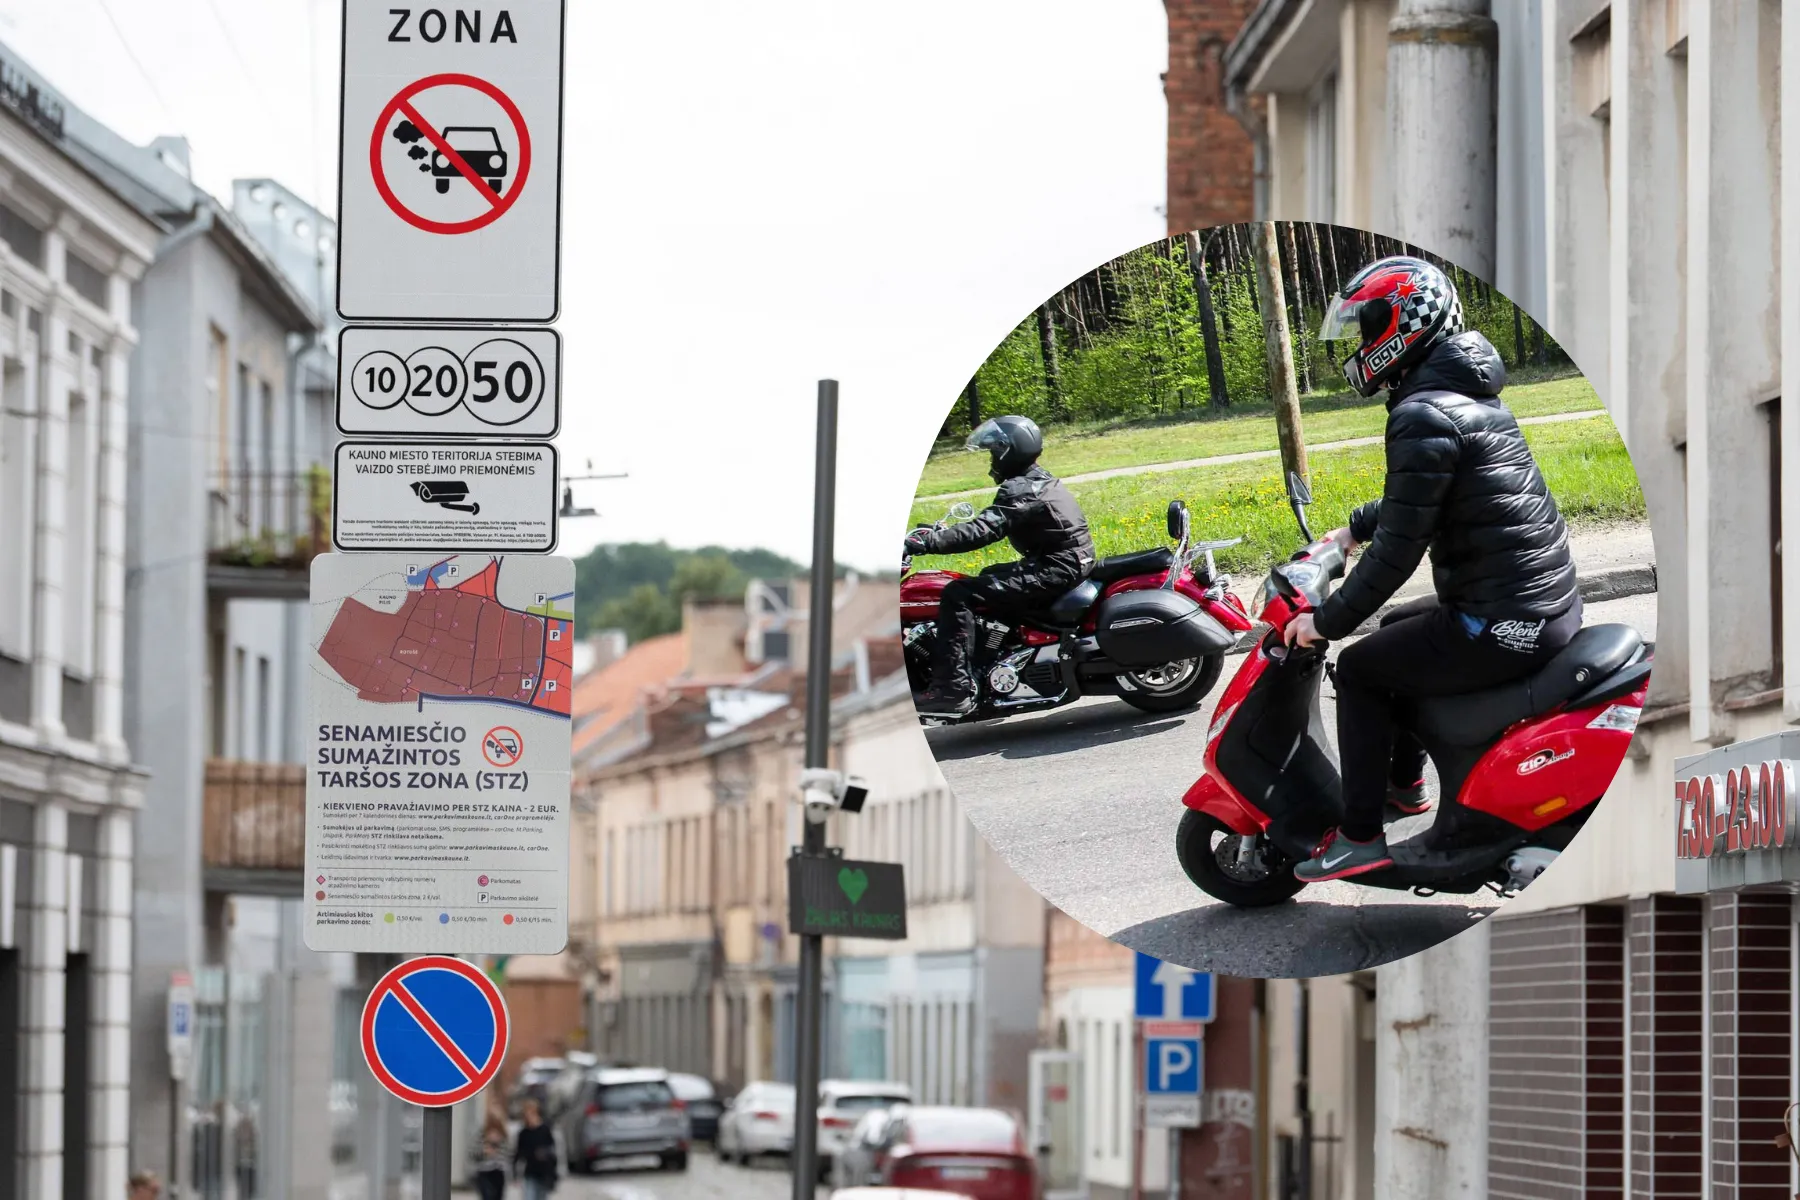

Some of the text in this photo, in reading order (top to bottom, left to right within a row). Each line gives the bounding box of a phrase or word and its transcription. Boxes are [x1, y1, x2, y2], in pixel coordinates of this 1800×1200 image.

[388, 8, 518, 44] ZONA
[365, 360, 533, 404] 10 20 50
[349, 450, 542, 462] KAUNO MIESTO TERITORIJA STEBIMA
[356, 462, 536, 476] VAIZDO STEBĖJIMO PRIEMONĖMIS
[410, 566, 416, 574] P
[451, 566, 457, 575] P
[538, 594, 544, 602] P
[1490, 618, 1546, 636] Blend
[552, 631, 558, 640] P
[524, 680, 530, 688] P
[548, 681, 554, 690] P
[318, 721, 466, 744] SENAMIESČIO
[318, 744, 462, 766] SUMAŽINTOS
[318, 766, 529, 792] TARŠOS ZONA (STZ)
[323, 802, 375, 811] KIEKVIENO
[378, 802, 450, 812] PRAVAŽIAVIMO
[472, 804, 489, 812] STZ
[1159, 1042, 1192, 1090] P
